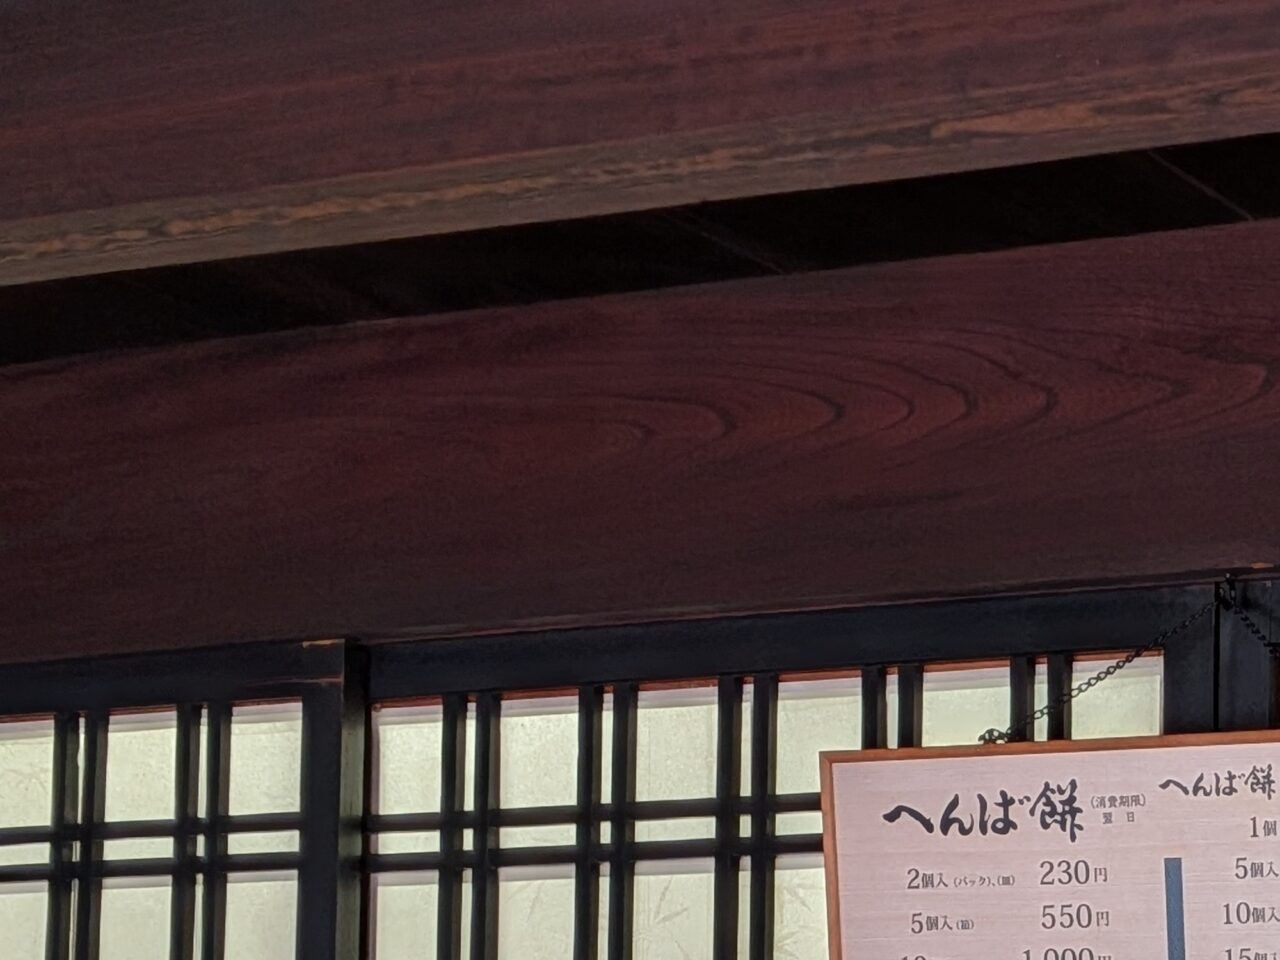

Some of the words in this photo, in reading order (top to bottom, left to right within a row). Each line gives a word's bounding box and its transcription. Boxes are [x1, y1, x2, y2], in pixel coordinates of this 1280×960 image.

[882, 779, 1084, 842] へんば餅
[1040, 860, 1108, 885] 230円
[1041, 904, 1110, 929] 550円
